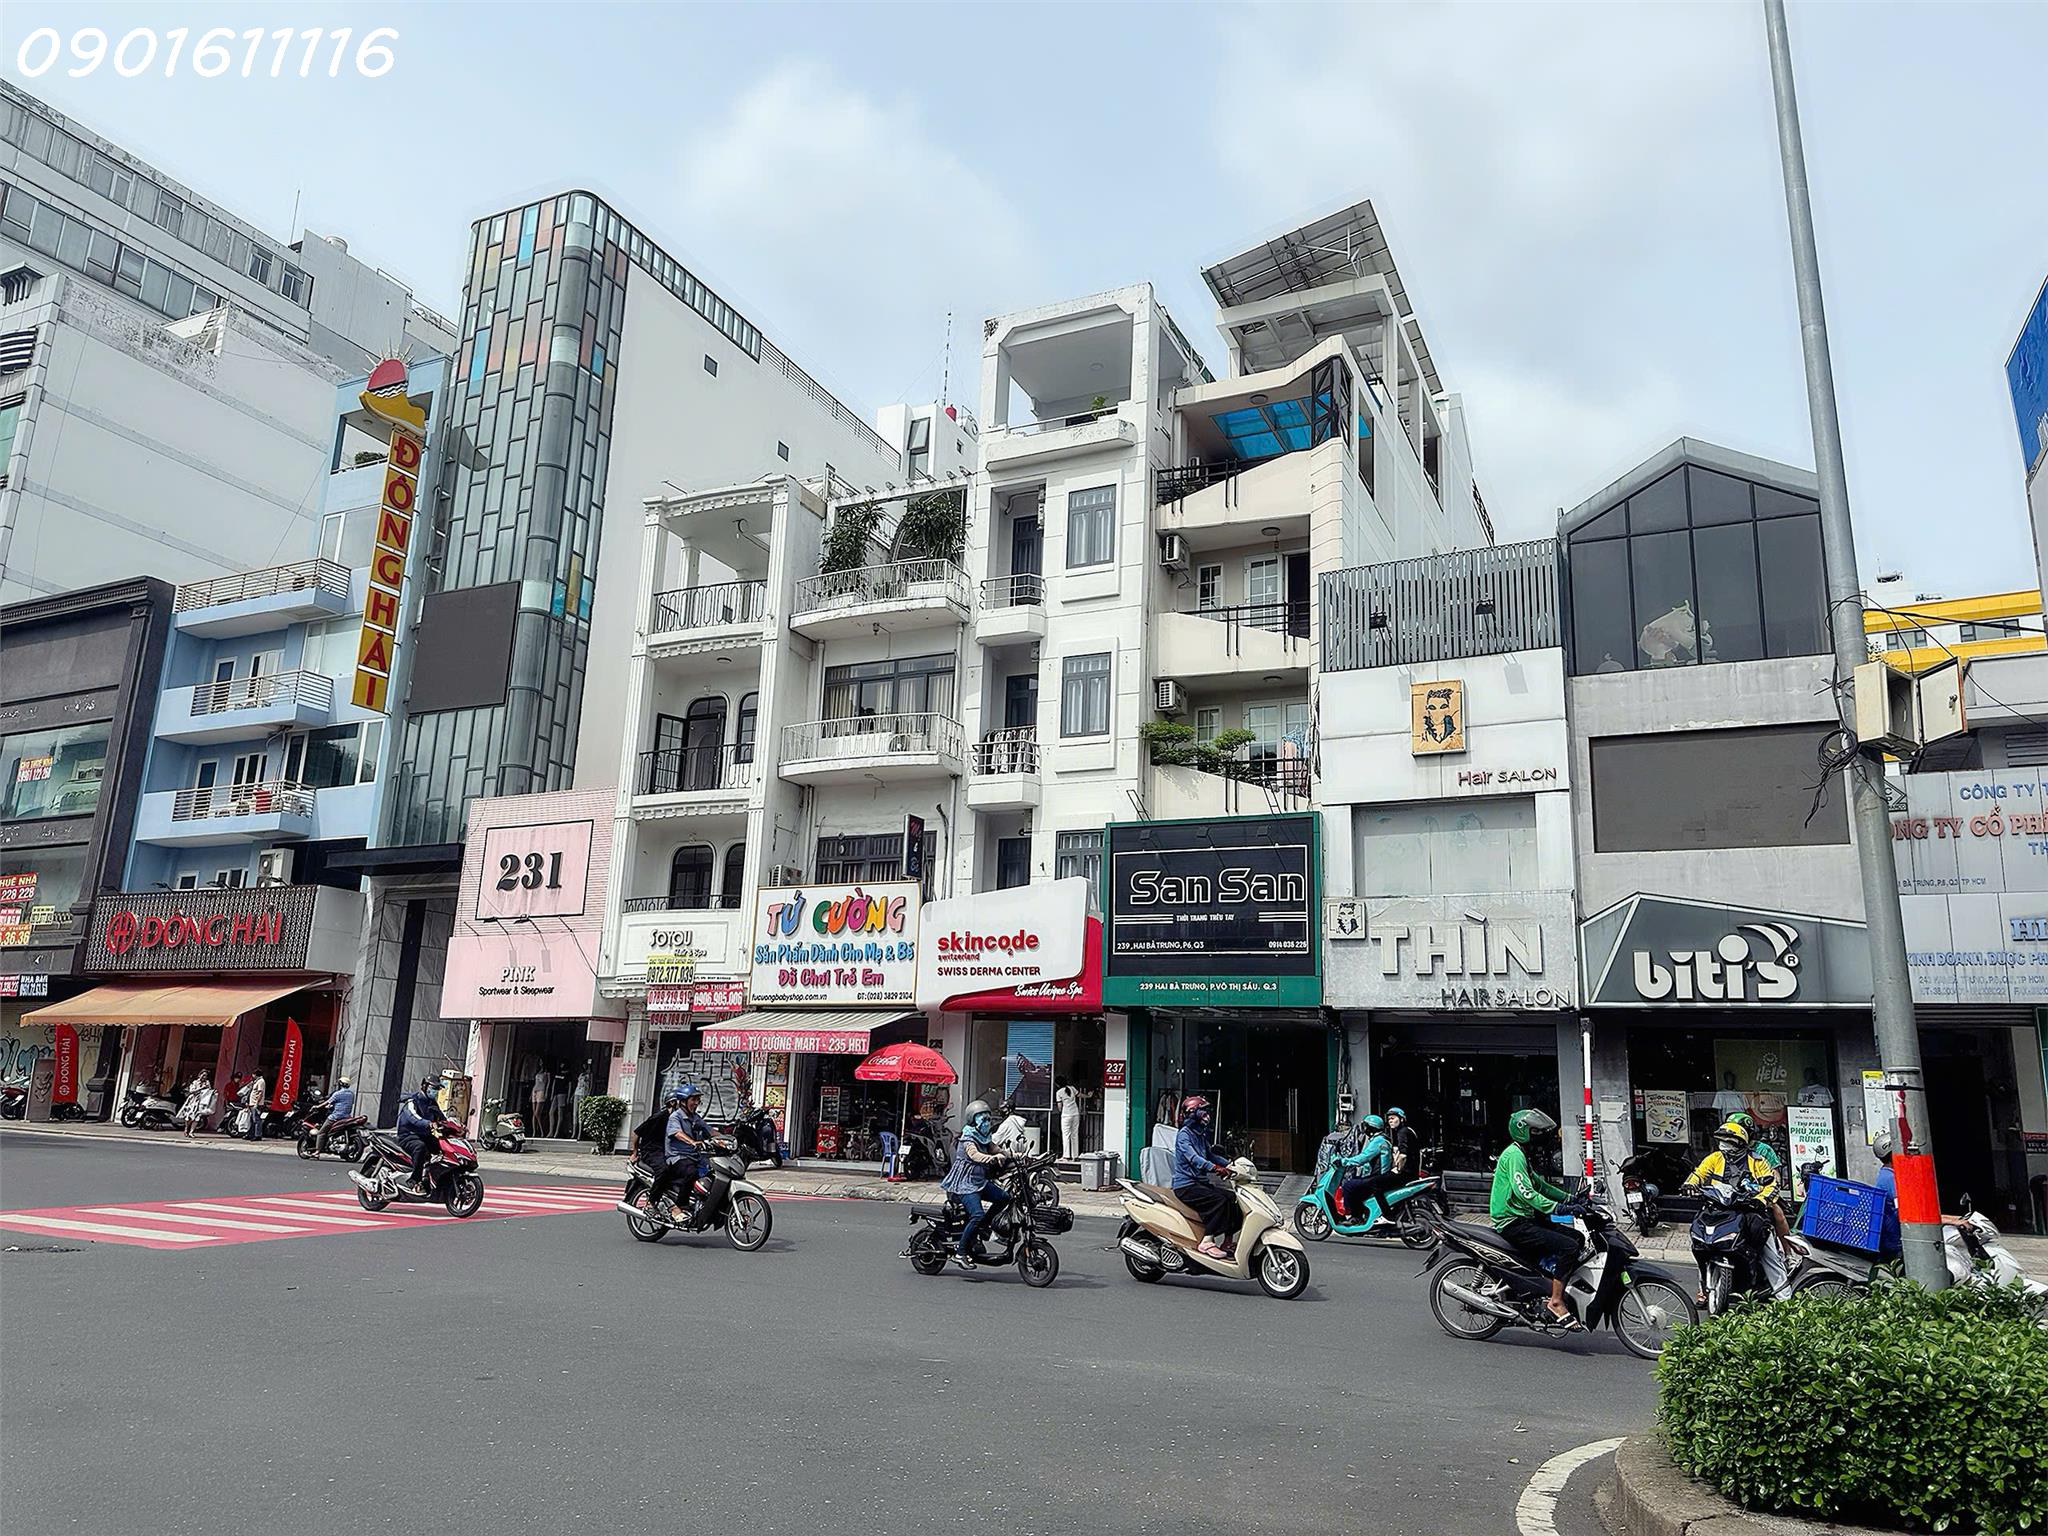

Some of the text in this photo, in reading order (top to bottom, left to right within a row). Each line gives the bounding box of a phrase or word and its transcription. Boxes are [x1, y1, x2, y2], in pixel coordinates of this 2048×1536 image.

[378, 435, 420, 585] ĐÔNG
[1458, 767, 1557, 787] Hair SALON
[1960, 783, 2007, 800] CÔNG
[2013, 783, 2035, 797] TY
[1934, 817, 1963, 838] TY
[1970, 804, 2005, 837] CỔ
[496, 852, 562, 891] 231
[1130, 868, 1305, 905] San San
[812, 887, 907, 934] CƯỜNG
[650, 928, 693, 947] SOYOU
[937, 929, 1040, 951] skincode
[1371, 908, 1543, 975] THÌN
[755, 942, 914, 965] Sản Phẩm Dành Cho Mẹ & Bé
[938, 953, 980, 962] switzerland
[501, 966, 537, 983] PINK
[778, 967, 885, 987] Đồ Chơi Trẻ Em
[937, 966, 1041, 977] SWISS DERMA CENTER
[478, 984, 555, 997] Sportwear & Sleepwear
[1140, 983, 1153, 991] 239
[1169, 980, 1180, 990] BÀ
[1228, 983, 1242, 992] THỊ
[752, 993, 827, 1005] tucuongbabyshop.com.vn
[1441, 986, 1570, 1007] HAIR SALON
[795, 1036, 820, 1050] MART
[828, 1037, 846, 1051] 235
[1106, 1062, 1124, 1073] 237
[1808, 1128, 1832, 1136] XANH
